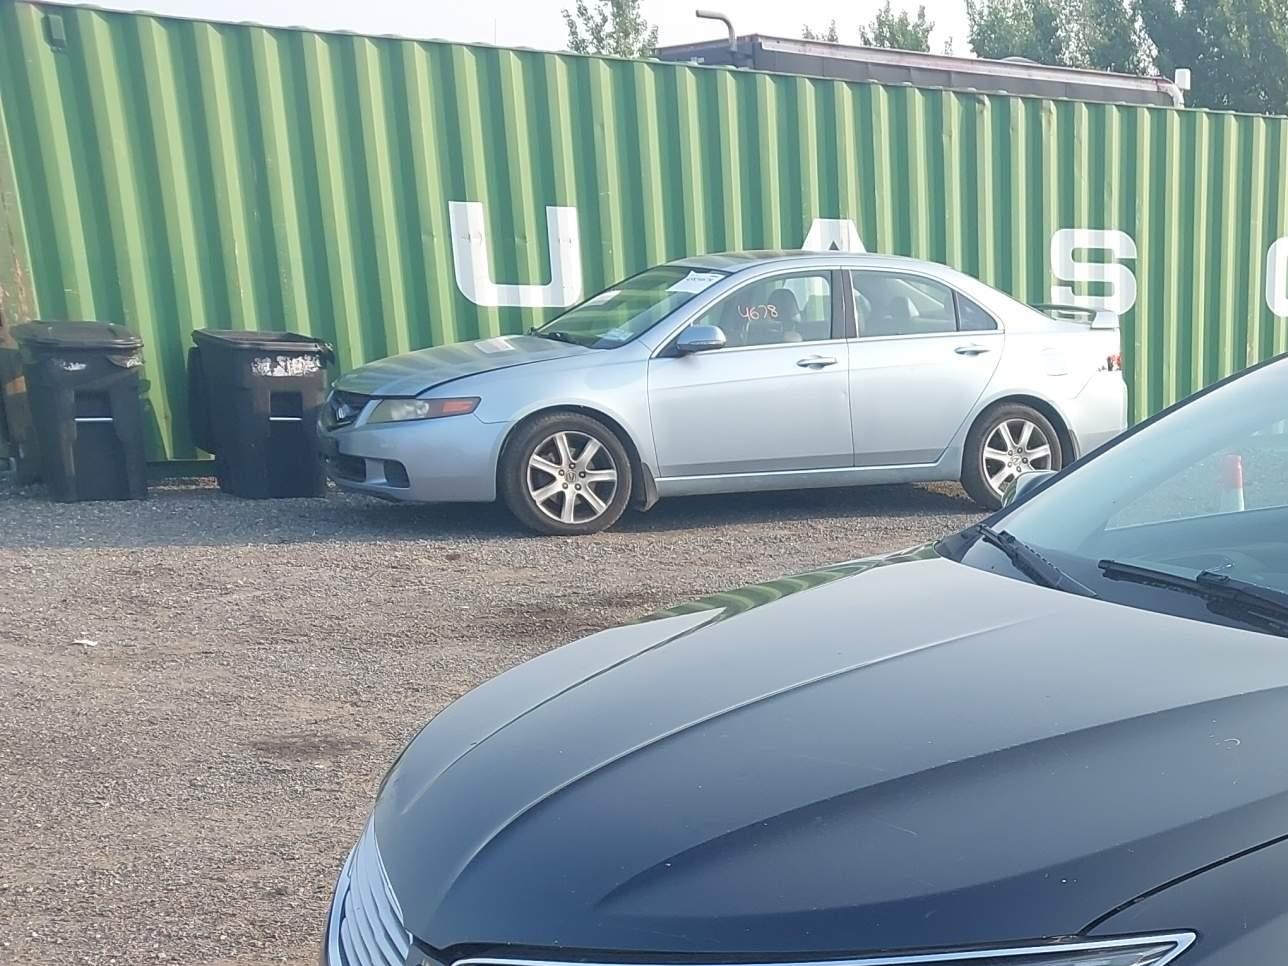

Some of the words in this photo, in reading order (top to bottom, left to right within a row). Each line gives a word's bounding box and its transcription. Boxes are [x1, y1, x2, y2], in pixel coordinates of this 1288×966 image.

[449, 201, 582, 308] U
[1049, 229, 1138, 314] S
[737, 304, 778, 321] 4678
